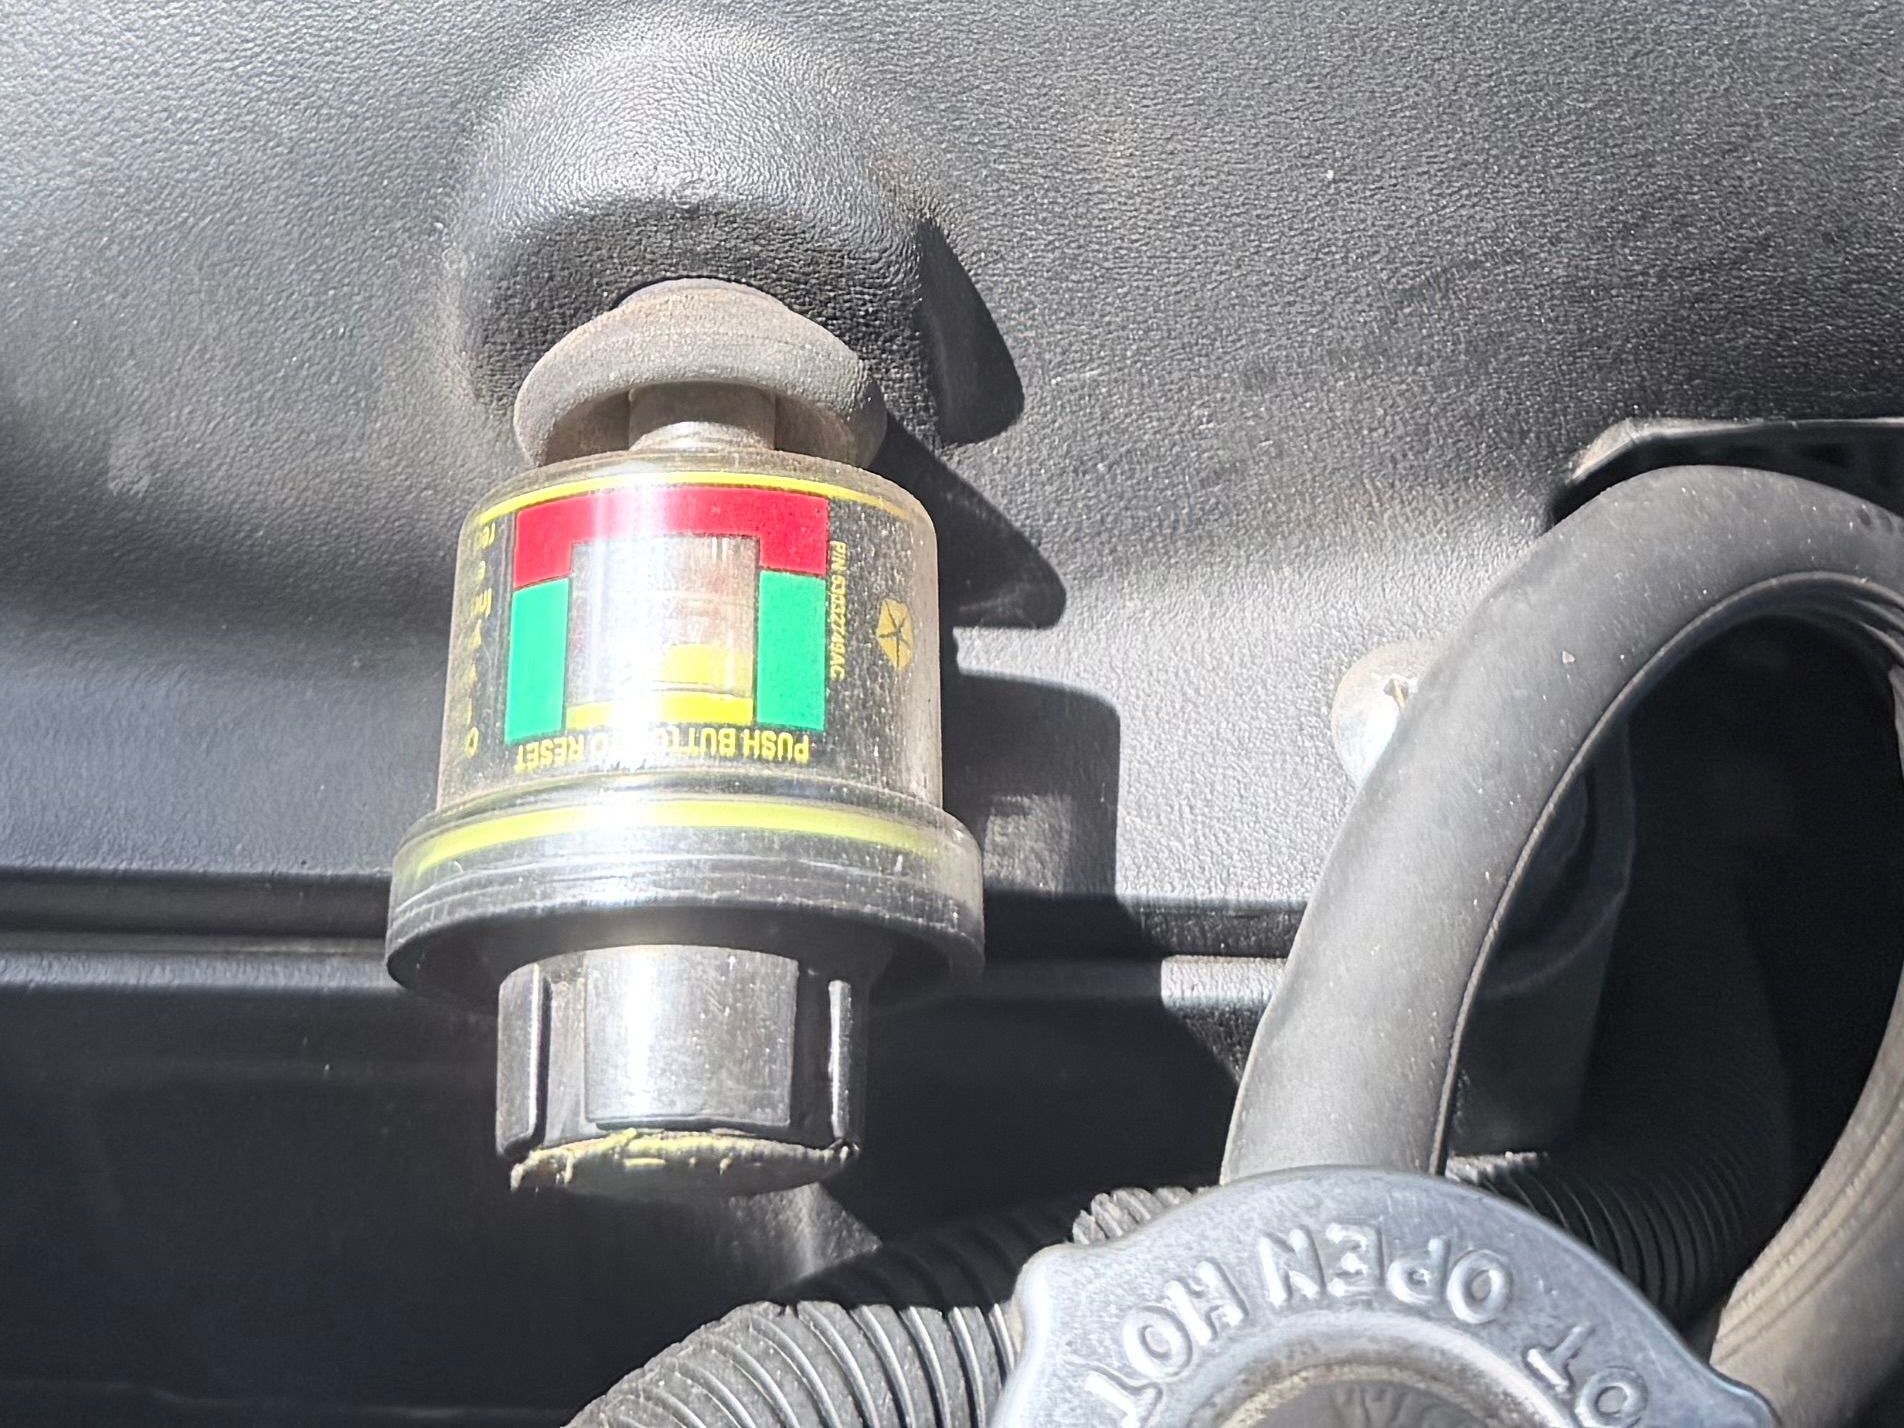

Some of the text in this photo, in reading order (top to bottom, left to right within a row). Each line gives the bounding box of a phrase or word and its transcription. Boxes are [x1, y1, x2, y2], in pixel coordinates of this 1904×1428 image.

[514, 733, 586, 773] RESET
[648, 726, 738, 758] BUTTO
[745, 726, 810, 764] PUSH
[1259, 1221, 1515, 1326] OPEN
[1523, 1321, 1650, 1428] OT
